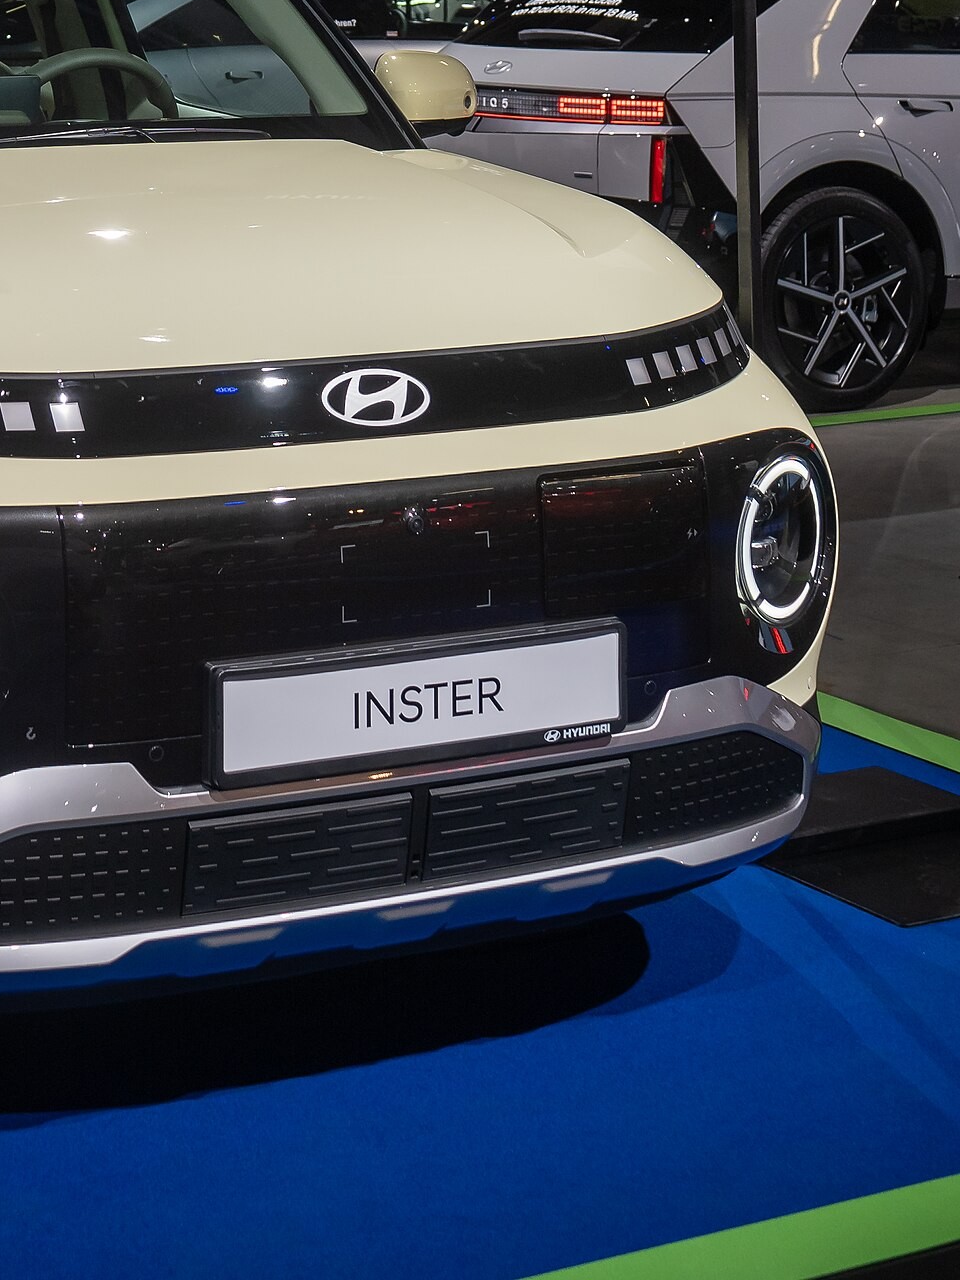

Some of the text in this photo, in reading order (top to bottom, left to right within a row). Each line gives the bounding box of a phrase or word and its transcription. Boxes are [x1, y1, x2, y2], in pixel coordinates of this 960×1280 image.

[502, 97, 509, 109] 5
[353, 676, 505, 730] INSTER
[563, 722, 611, 739] HYUNDAI
